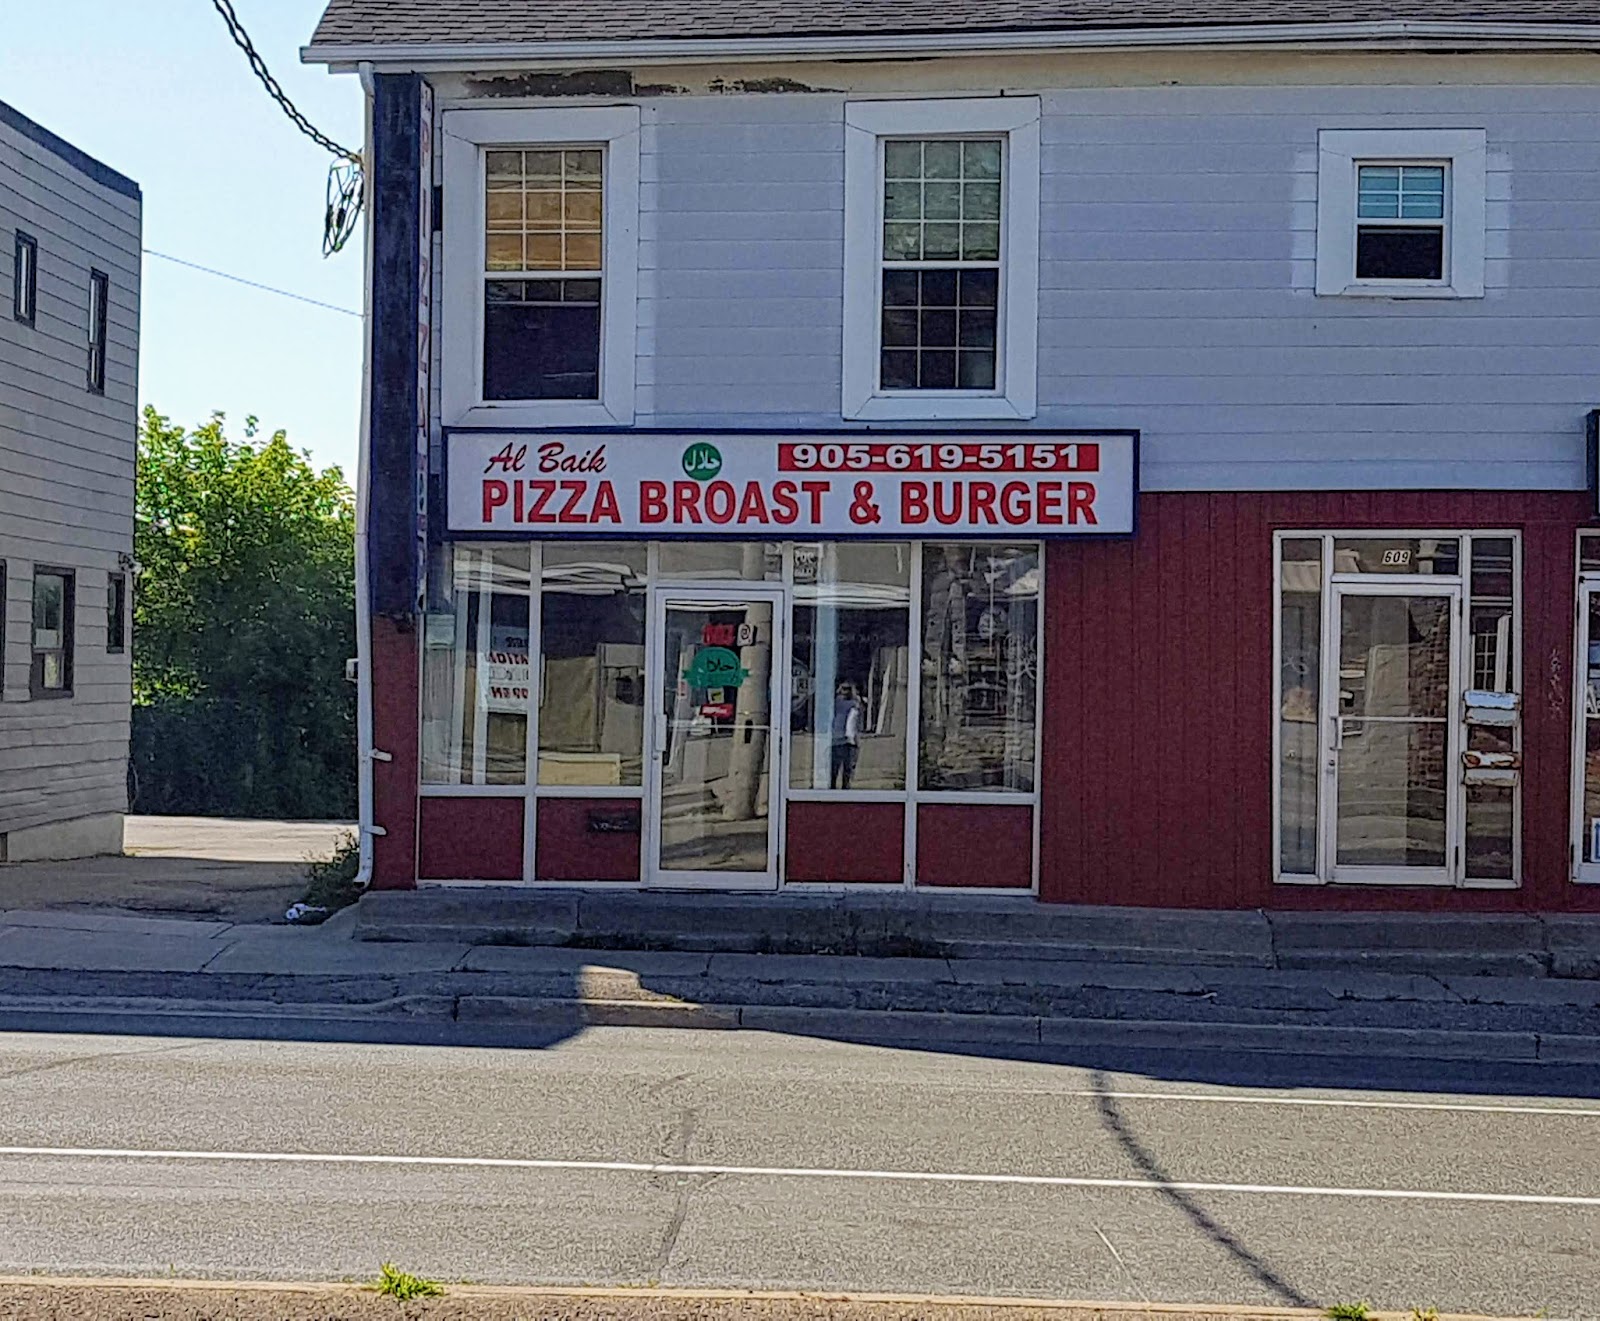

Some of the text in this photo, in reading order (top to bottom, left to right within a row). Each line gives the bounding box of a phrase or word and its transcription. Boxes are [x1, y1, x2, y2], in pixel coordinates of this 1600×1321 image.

[484, 442, 607, 473] Al Baik
[684, 450, 721, 471] حلال
[792, 444, 1079, 469] 905-619-5151
[482, 480, 1098, 525] PIZZA BROAST & BURGER
[1384, 551, 1409, 563] 609
